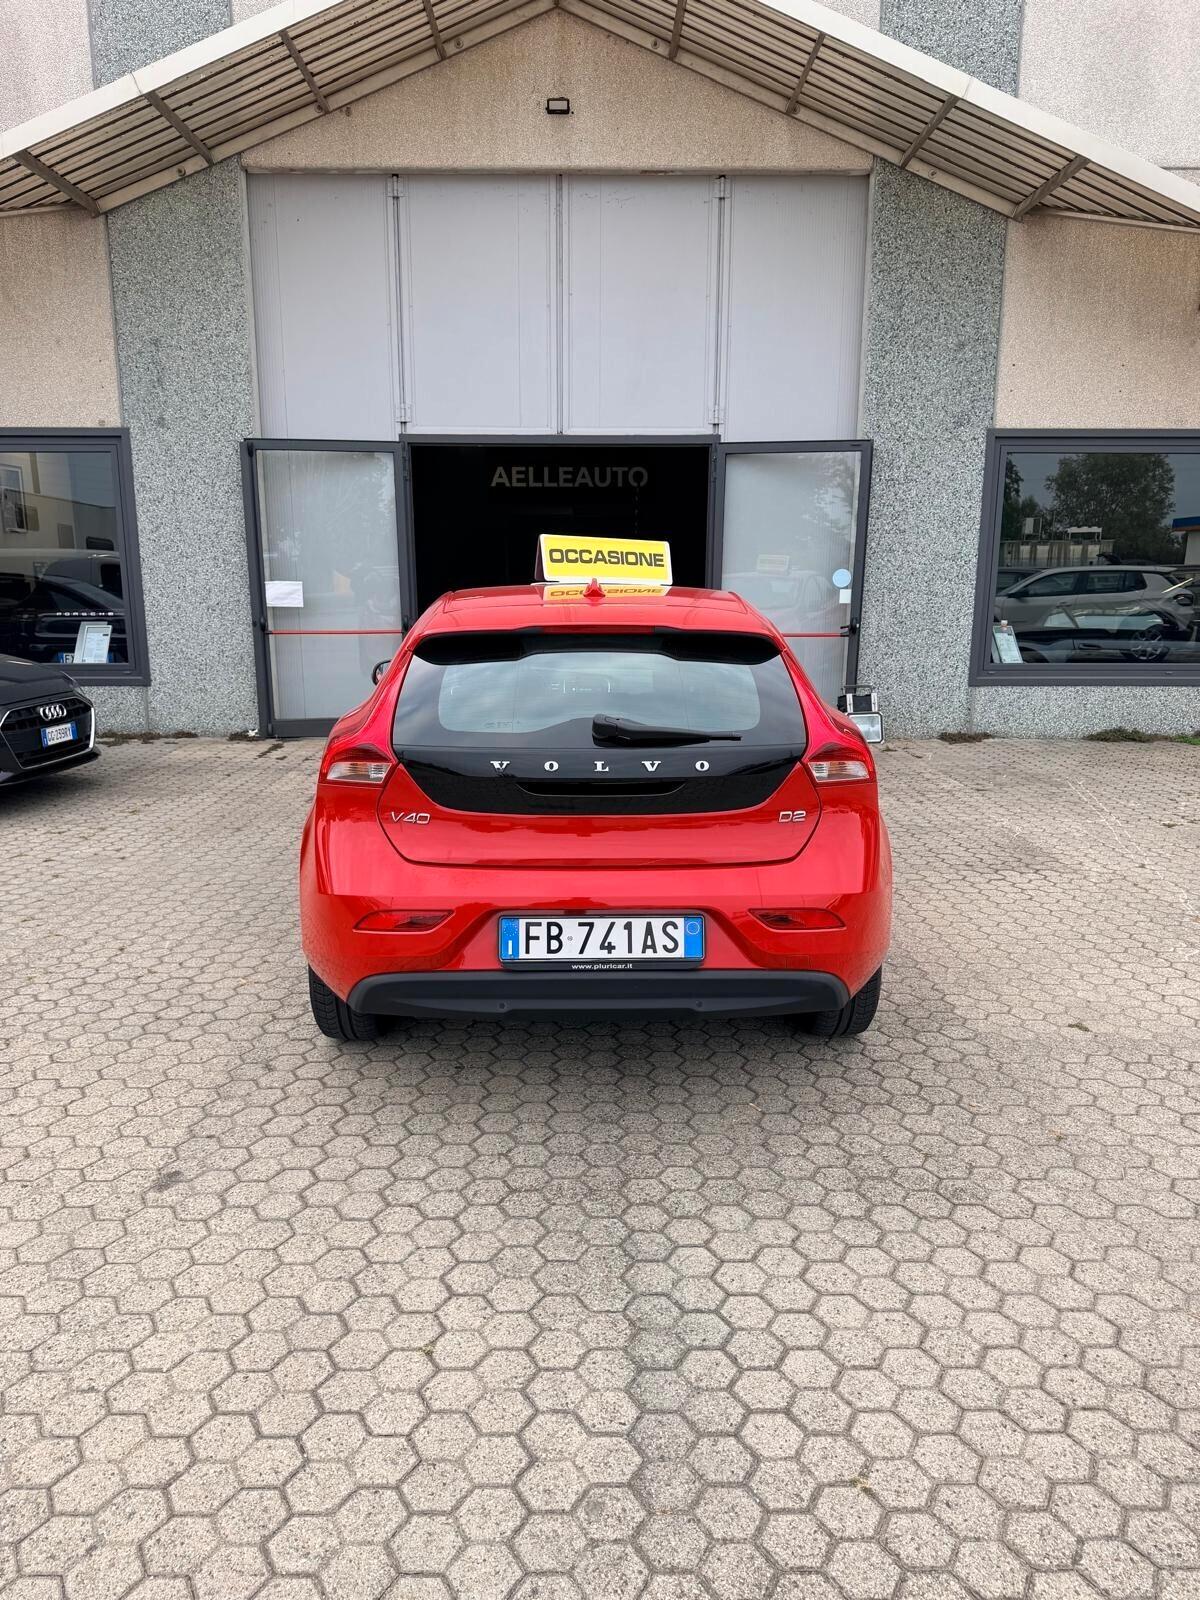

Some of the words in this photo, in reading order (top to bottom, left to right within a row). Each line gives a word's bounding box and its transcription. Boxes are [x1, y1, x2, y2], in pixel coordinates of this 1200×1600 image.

[490, 466, 649, 488] AELLEAUTO
[548, 548, 665, 567] OCCASIONE
[489, 760, 710, 773] VOLVO
[391, 811, 431, 824] V40
[778, 810, 806, 823] D2
